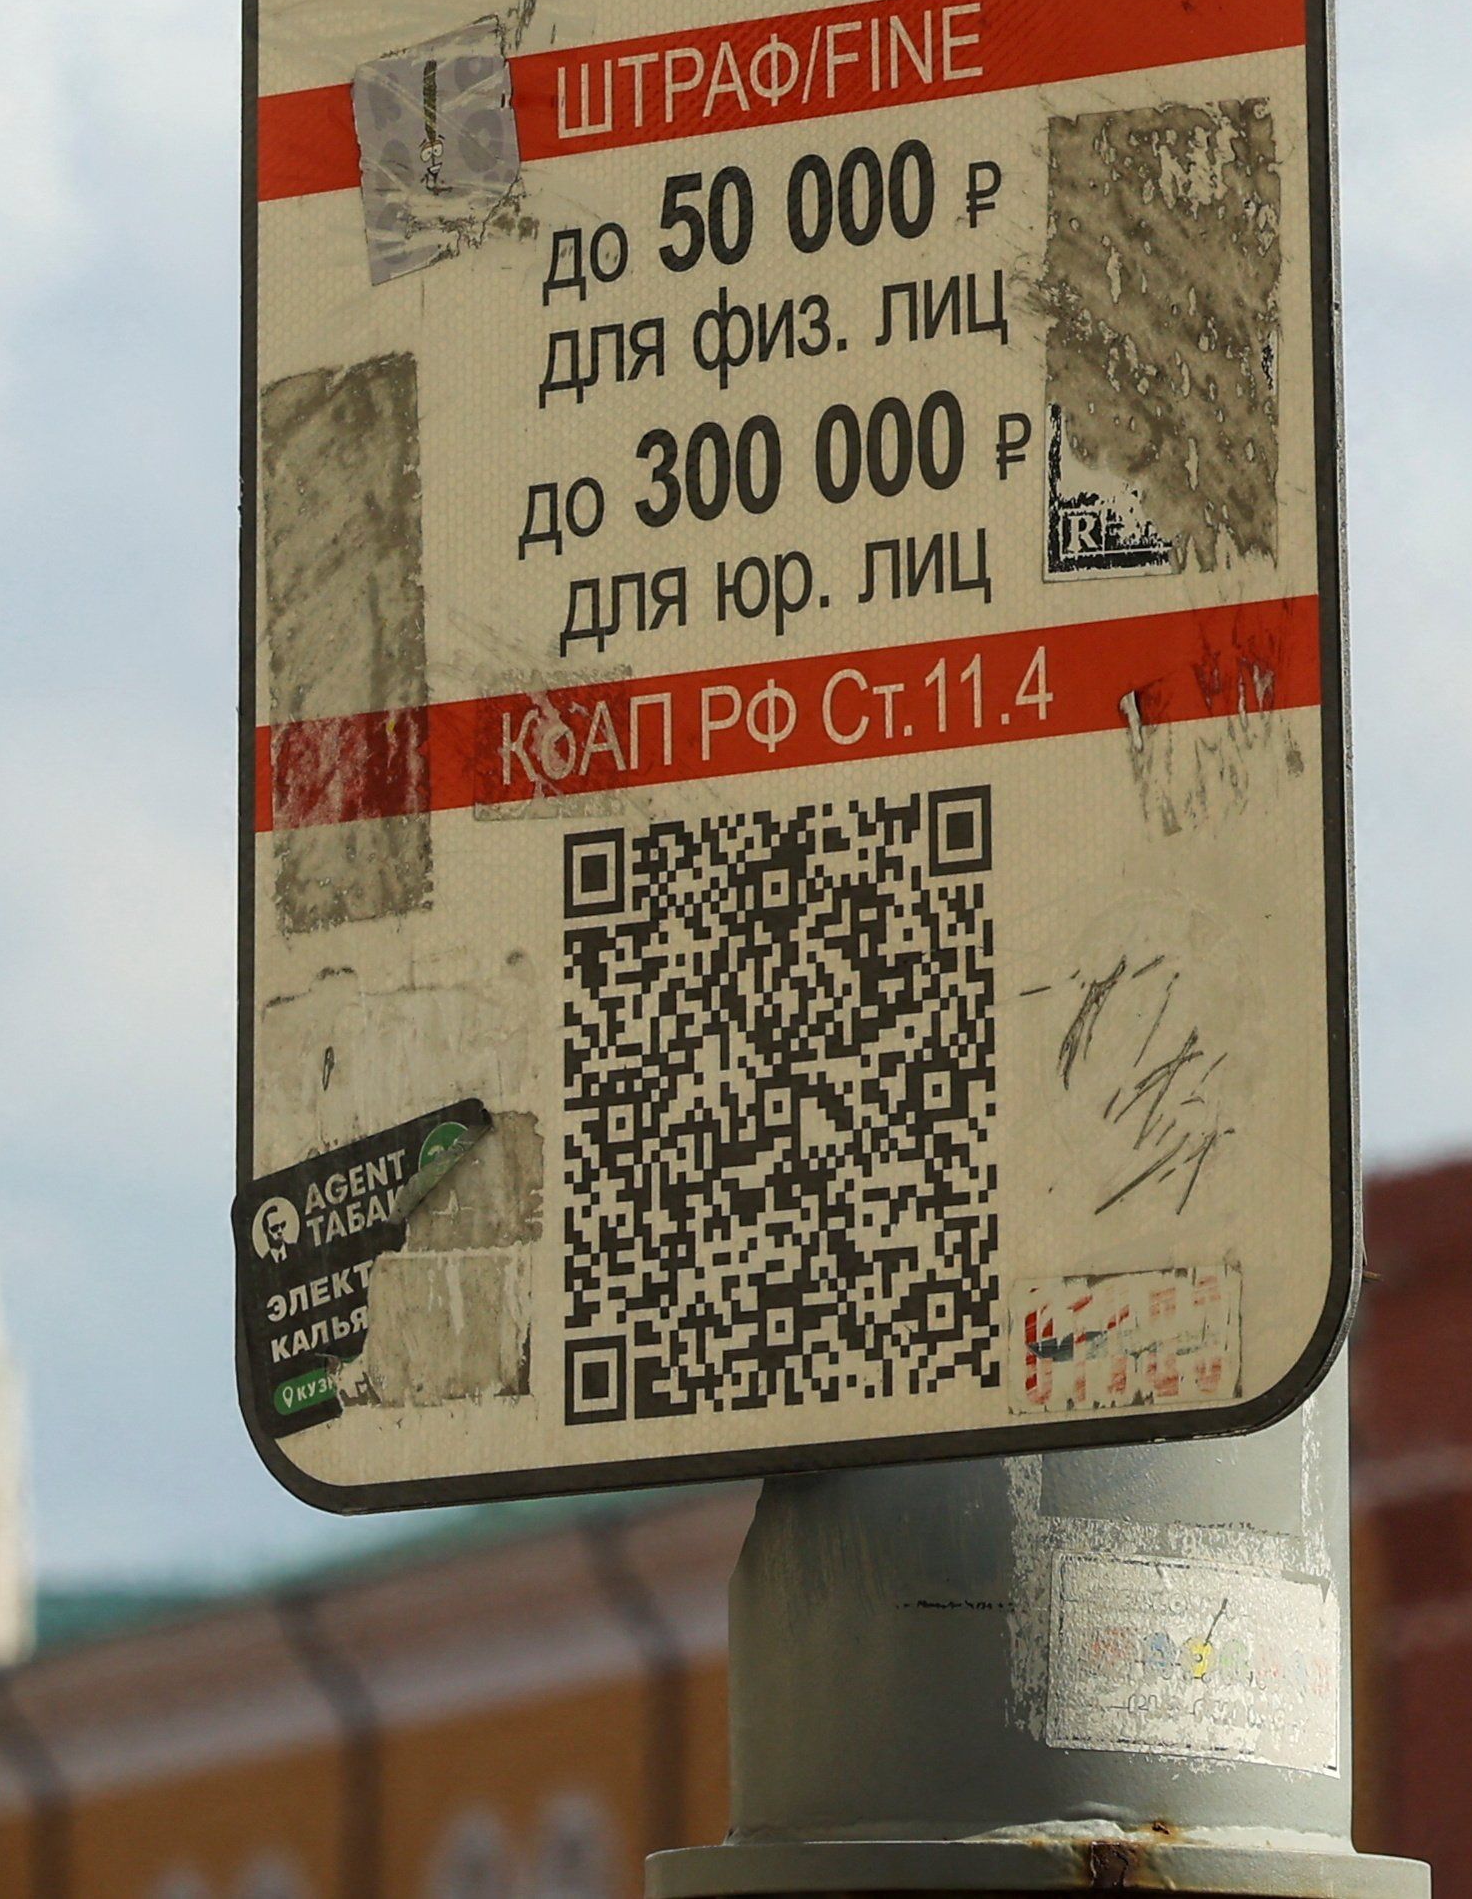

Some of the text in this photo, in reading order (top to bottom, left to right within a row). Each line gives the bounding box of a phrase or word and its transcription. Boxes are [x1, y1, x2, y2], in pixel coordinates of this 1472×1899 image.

[557, 2, 985, 140] ШТРАФ/FINE
[543, 222, 629, 306] до
[659, 166, 756, 274] 50
[787, 139, 936, 254] 000
[538, 268, 1009, 409] для физ. лиц
[518, 476, 604, 559] до
[634, 411, 779, 528] 300
[814, 389, 965, 505] 000
[559, 526, 992, 657] для юр. лиц
[701, 678, 798, 762] РФ
[821, 645, 1055, 745] Ст.11.4
[305, 1148, 406, 1216] AGENT
